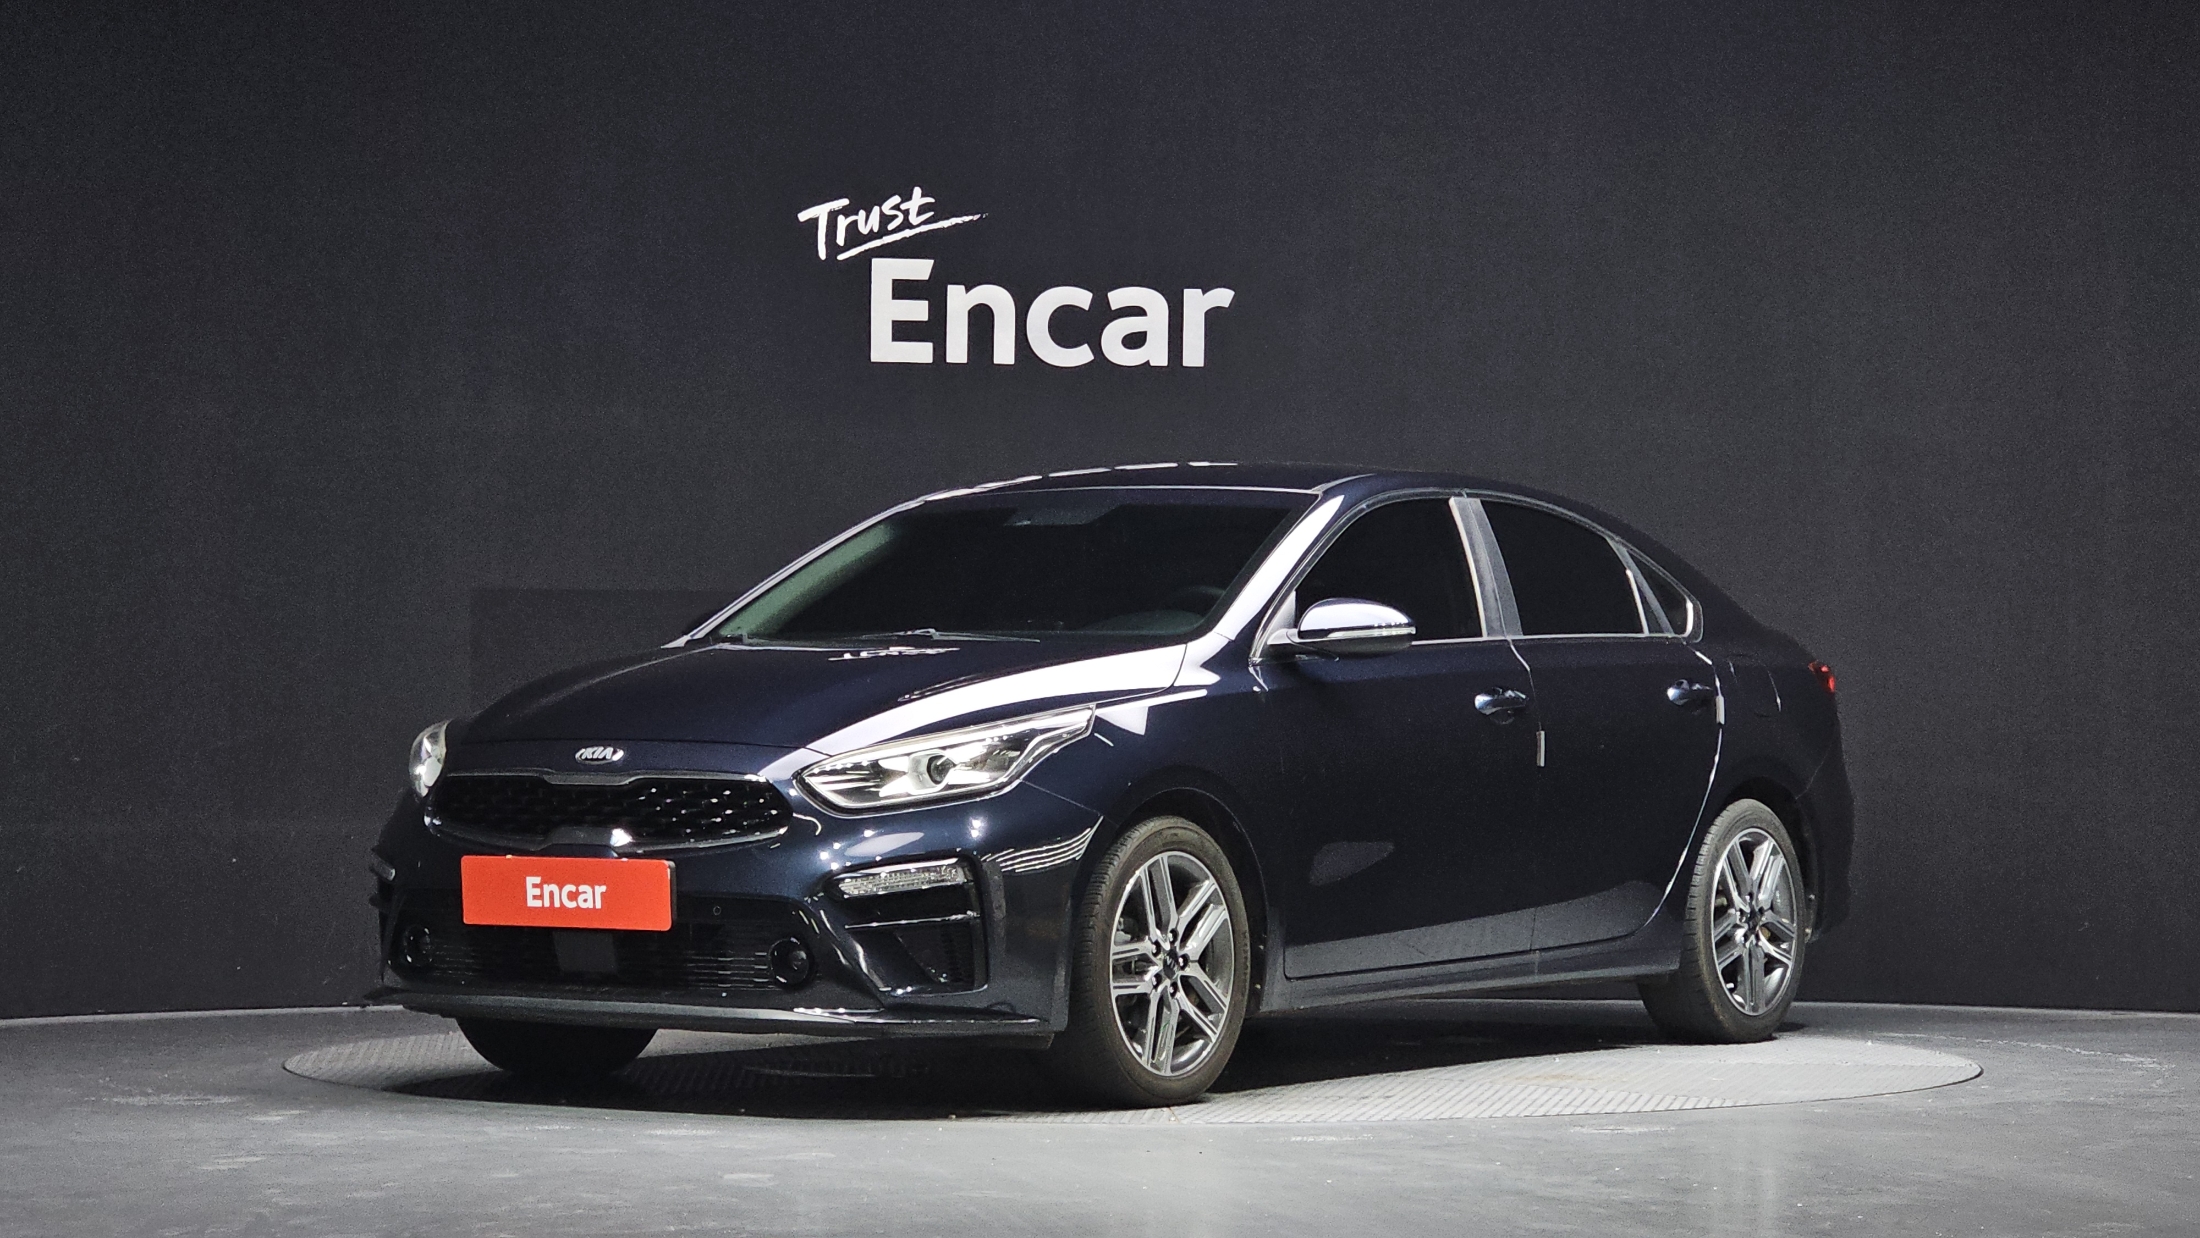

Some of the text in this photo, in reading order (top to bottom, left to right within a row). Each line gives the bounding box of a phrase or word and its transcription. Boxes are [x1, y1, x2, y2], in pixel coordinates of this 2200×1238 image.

[798, 187, 935, 259] Trust
[871, 258, 1235, 367] Encar
[525, 876, 607, 909] Encar
